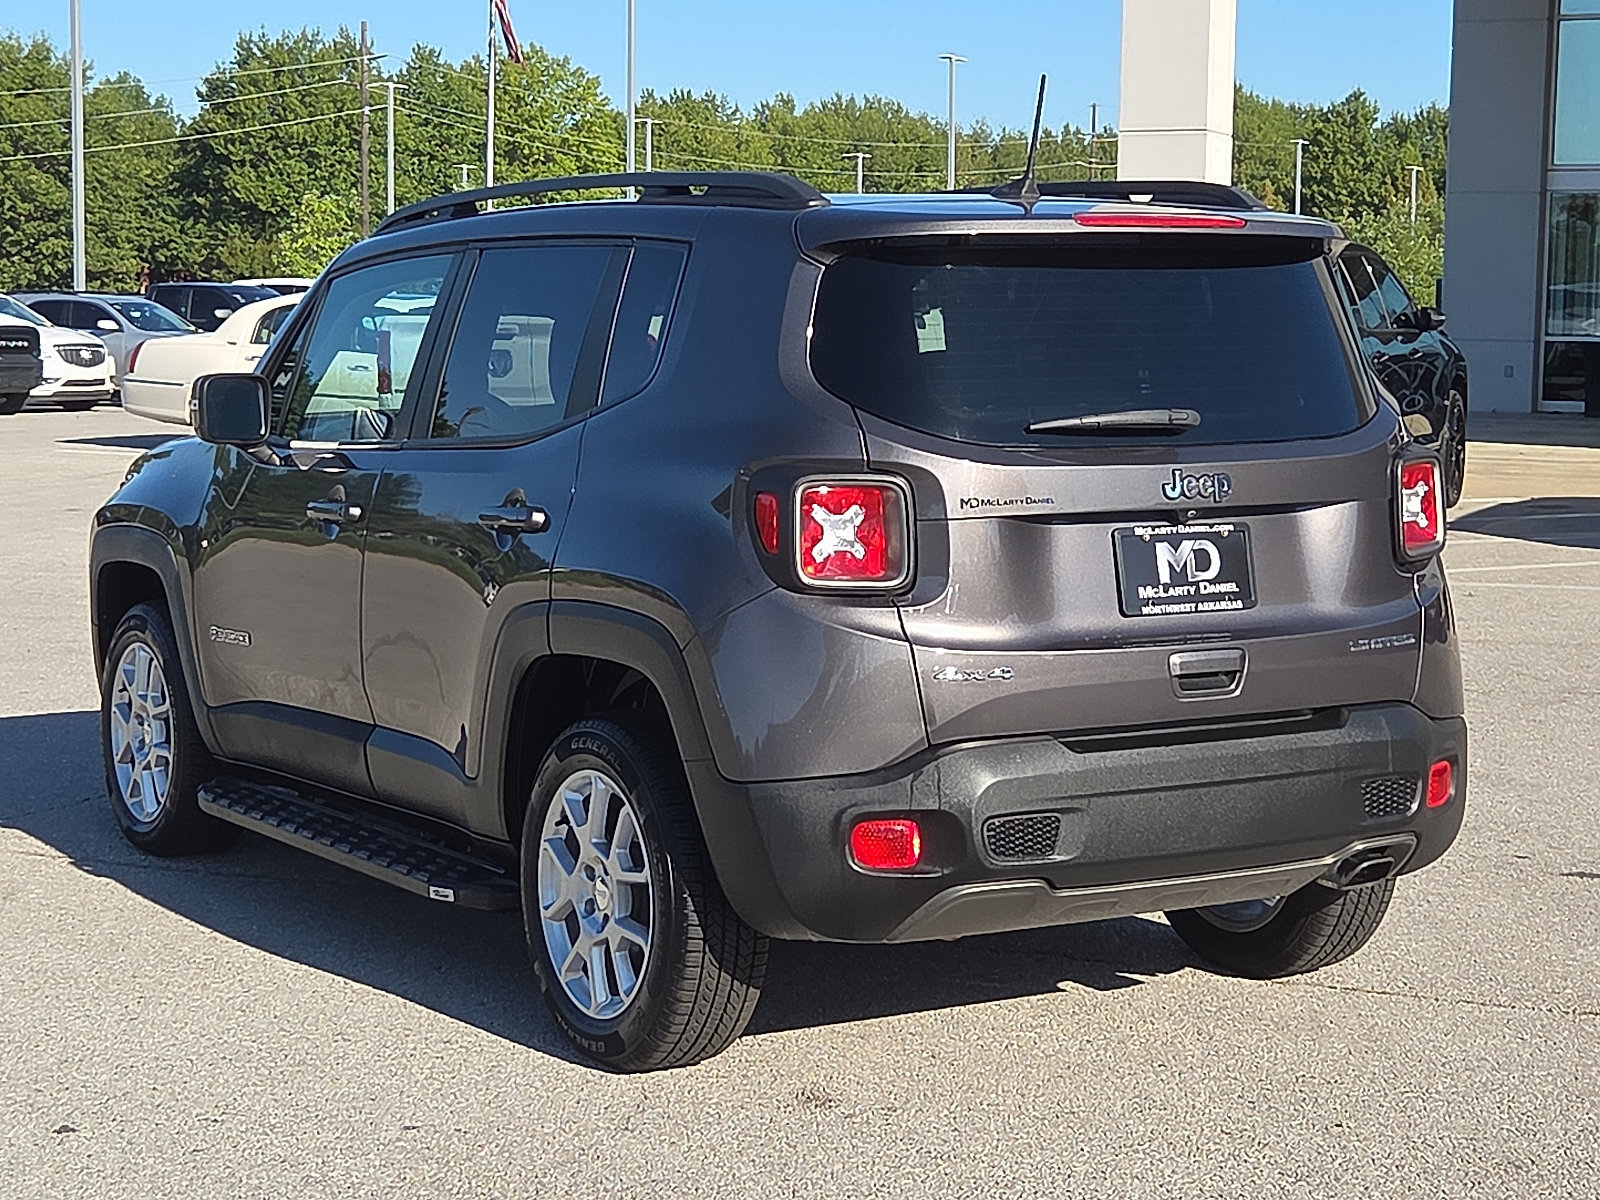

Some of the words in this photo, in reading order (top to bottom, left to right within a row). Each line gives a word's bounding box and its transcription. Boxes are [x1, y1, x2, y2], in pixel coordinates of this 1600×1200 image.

[1161, 468, 1233, 503] Jeep
[1155, 539, 1222, 584] MD
[1199, 581, 1240, 595] DANIEL
